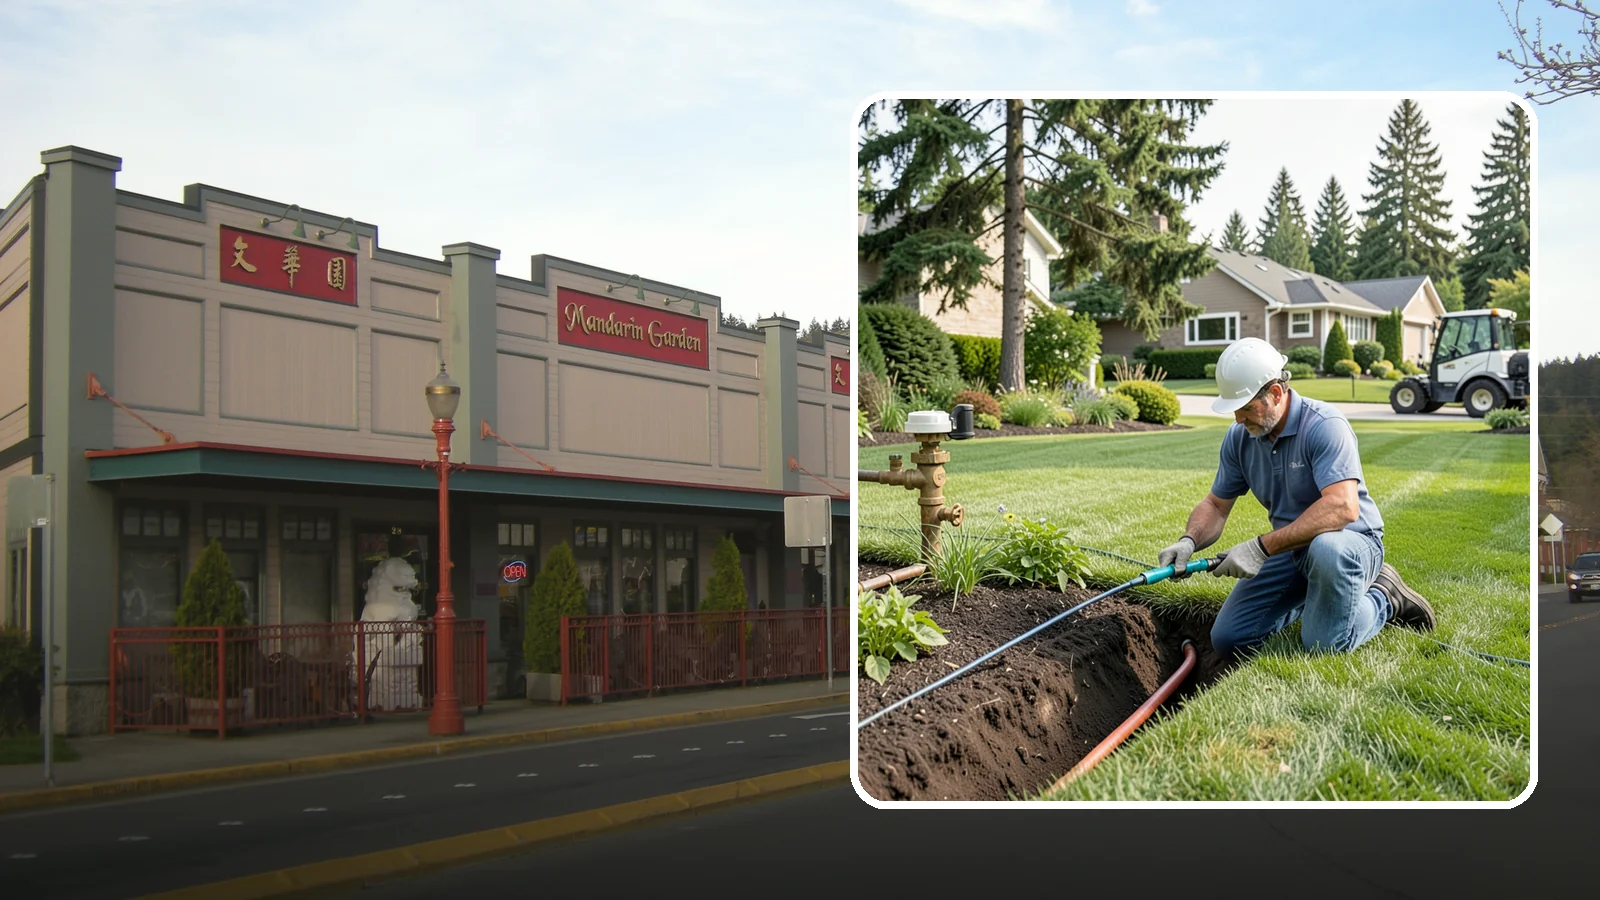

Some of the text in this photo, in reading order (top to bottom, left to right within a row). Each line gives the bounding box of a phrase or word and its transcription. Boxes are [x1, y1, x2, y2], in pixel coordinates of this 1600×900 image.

[565, 302, 701, 352] Mandarin Garden
[503, 565, 527, 578] OPEN
